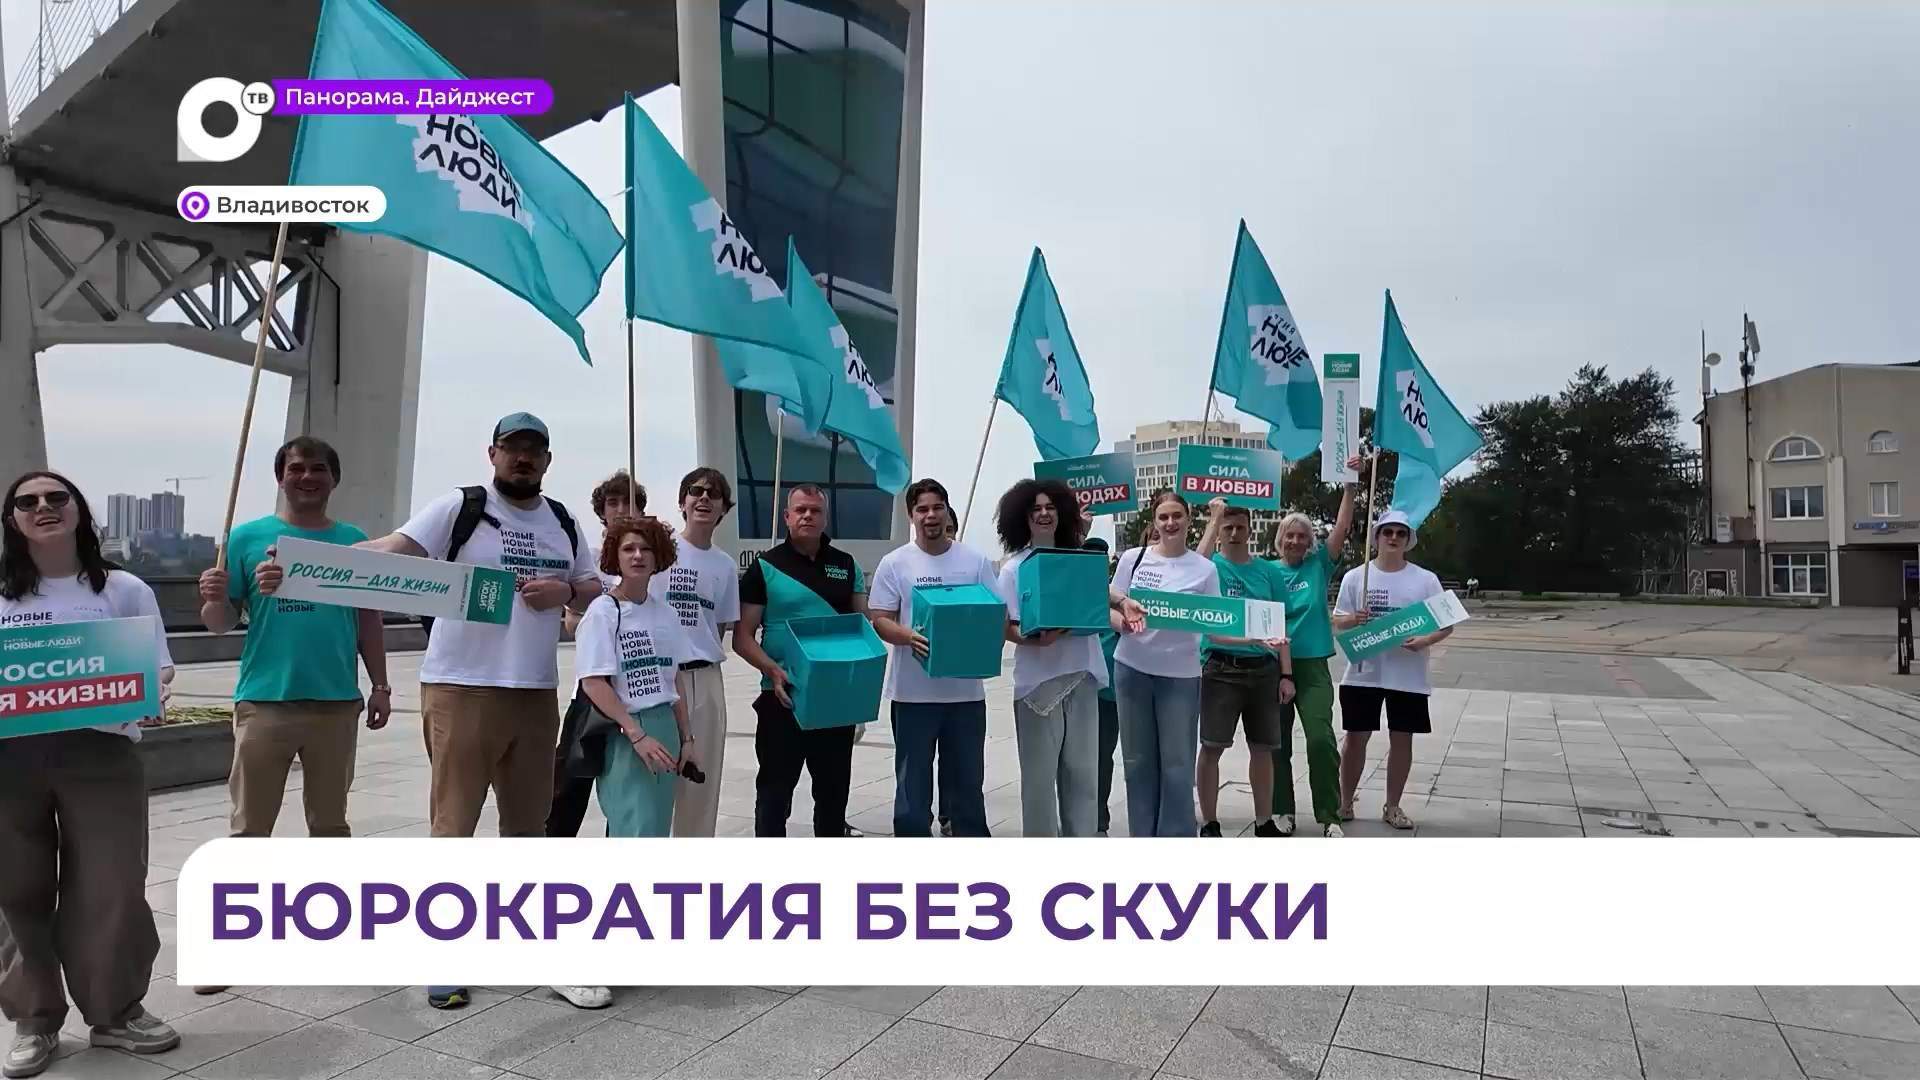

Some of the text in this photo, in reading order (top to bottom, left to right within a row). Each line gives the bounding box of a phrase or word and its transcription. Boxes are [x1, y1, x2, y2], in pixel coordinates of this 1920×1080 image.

[419, 143, 516, 218] ЛЮДИ
[718, 243, 771, 277] ЛЮ
[1209, 465, 1250, 478] СИЛА
[1067, 475, 1106, 488] СИЛА
[1186, 477, 1270, 497] В ЛЮБВИ
[1075, 486, 1126, 504] ЮДЯХ
[501, 530, 535, 540] НОВЫЕ
[504, 548, 537, 557] НОВЫЕ
[401, 575, 451, 594] ЖИЗНИ
[278, 604, 316, 613] НОВЫЕ
[2, 611, 53, 625] НОВЫЕ
[1193, 610, 1233, 625] ЛЮДИ
[619, 630, 649, 642] НОВЫЕ
[1352, 615, 1426, 652] НОВЫЕ ЛЮДИ
[4, 636, 82, 651] НОВЫЕ ЛЮДИ
[621, 639, 652, 650] НОВЫЕ
[623, 648, 655, 660] НОВЫЕ
[626, 667, 659, 680] НОВЫЕ
[627, 676, 661, 689] НОВЫЕ
[26, 679, 137, 709] ЖИЗНИ
[629, 685, 662, 699] НОВЫЕ
